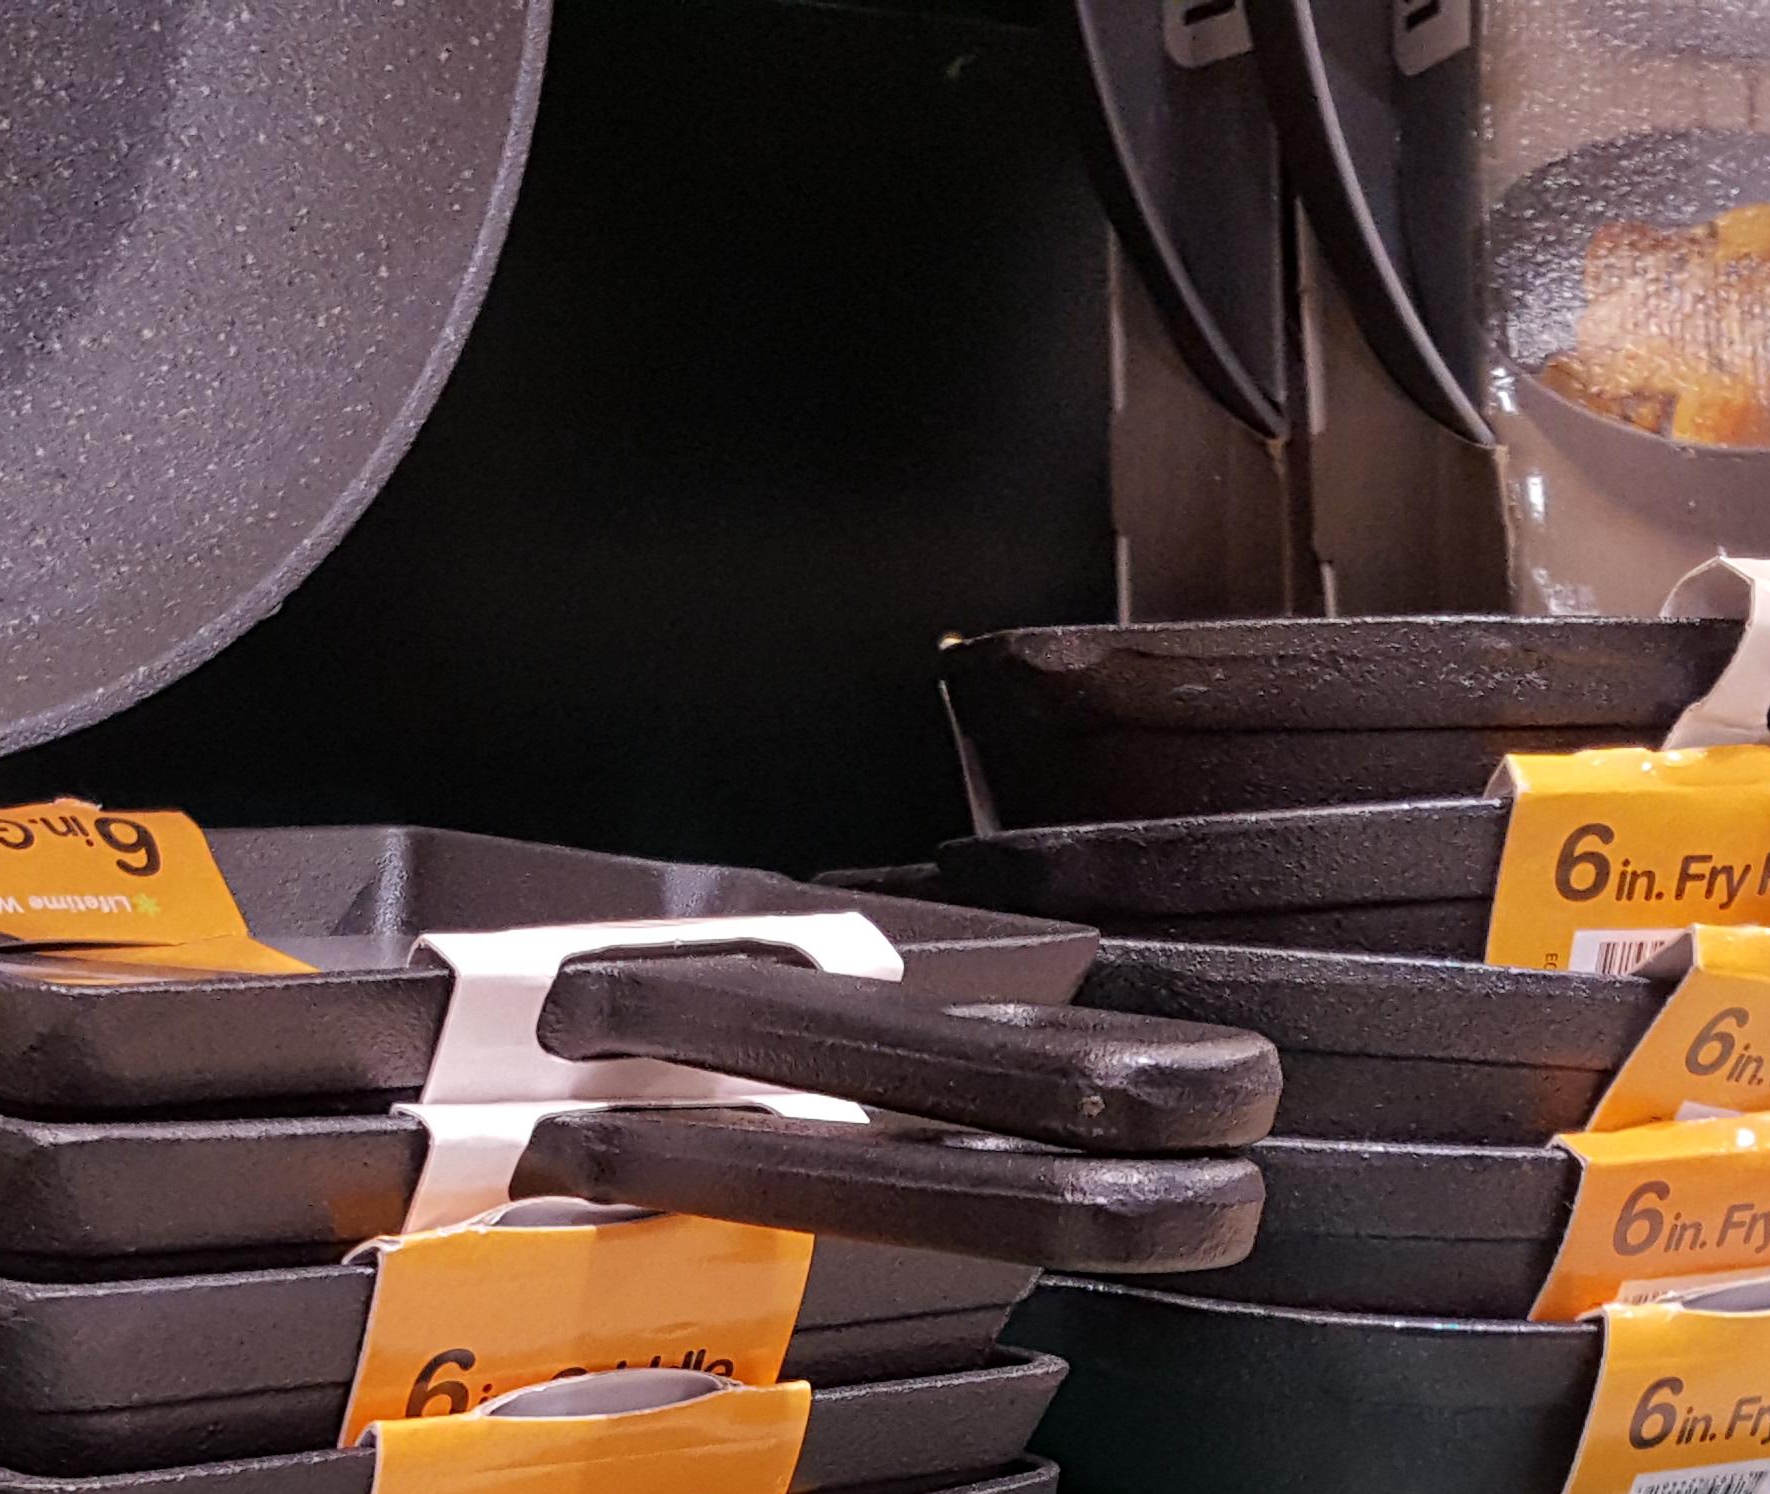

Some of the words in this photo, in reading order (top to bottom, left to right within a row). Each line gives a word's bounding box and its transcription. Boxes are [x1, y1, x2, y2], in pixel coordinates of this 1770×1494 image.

[101, 816, 161, 877] 6
[1554, 822, 1616, 904] 6
[1616, 858, 1665, 903] in.
[1675, 854, 1753, 910] Fry
[28, 894, 133, 915] Lifetime
[1683, 1006, 1749, 1078] 6
[1727, 1044, 1765, 1088] in.
[1612, 1180, 1671, 1258] 6
[1662, 1213, 1708, 1252] in.
[404, 1348, 477, 1418] 6
[1628, 1375, 1685, 1451] 6
[1675, 1404, 1717, 1447] in.
